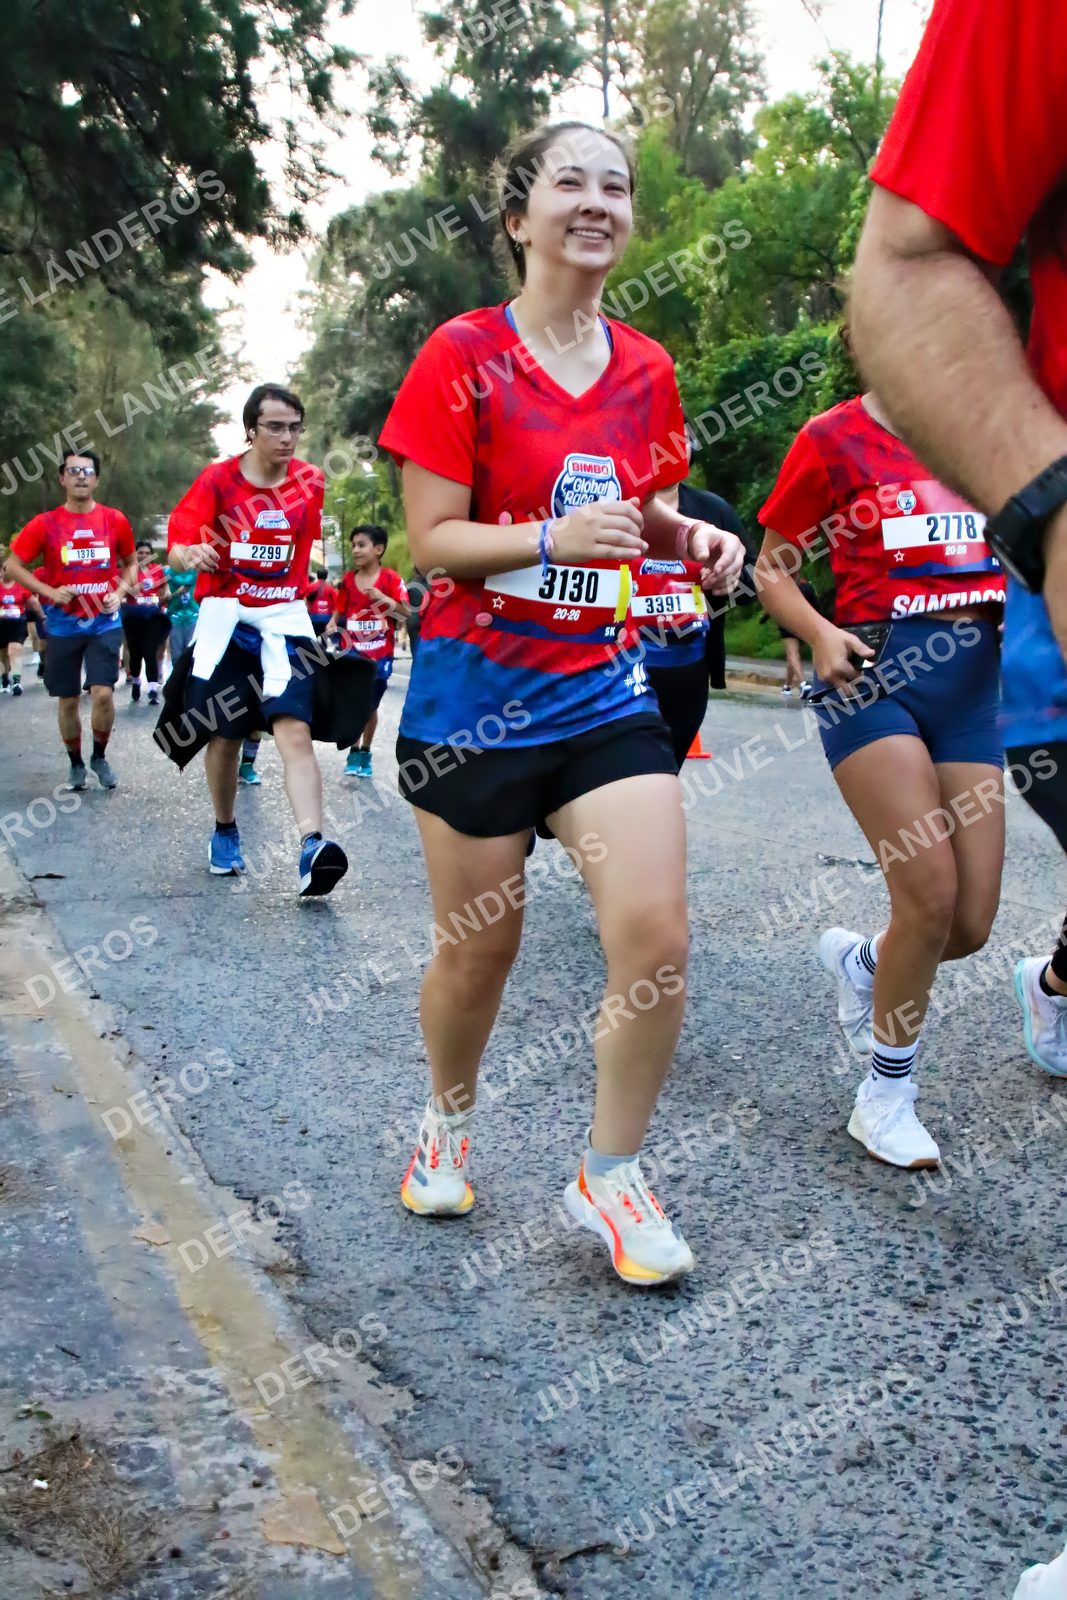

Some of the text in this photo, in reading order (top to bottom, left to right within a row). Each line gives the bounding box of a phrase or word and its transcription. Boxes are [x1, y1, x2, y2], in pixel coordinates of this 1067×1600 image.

[572, 462, 609, 475] BIMBO
[573, 477, 609, 496] Global
[563, 490, 595, 506] Race
[926, 514, 977, 542] 2778
[77, 549, 95, 559] 1378
[251, 545, 281, 560] 2299
[538, 567, 599, 604] 3130
[645, 594, 682, 614] 3391
[604, 625, 616, 637] 5K
